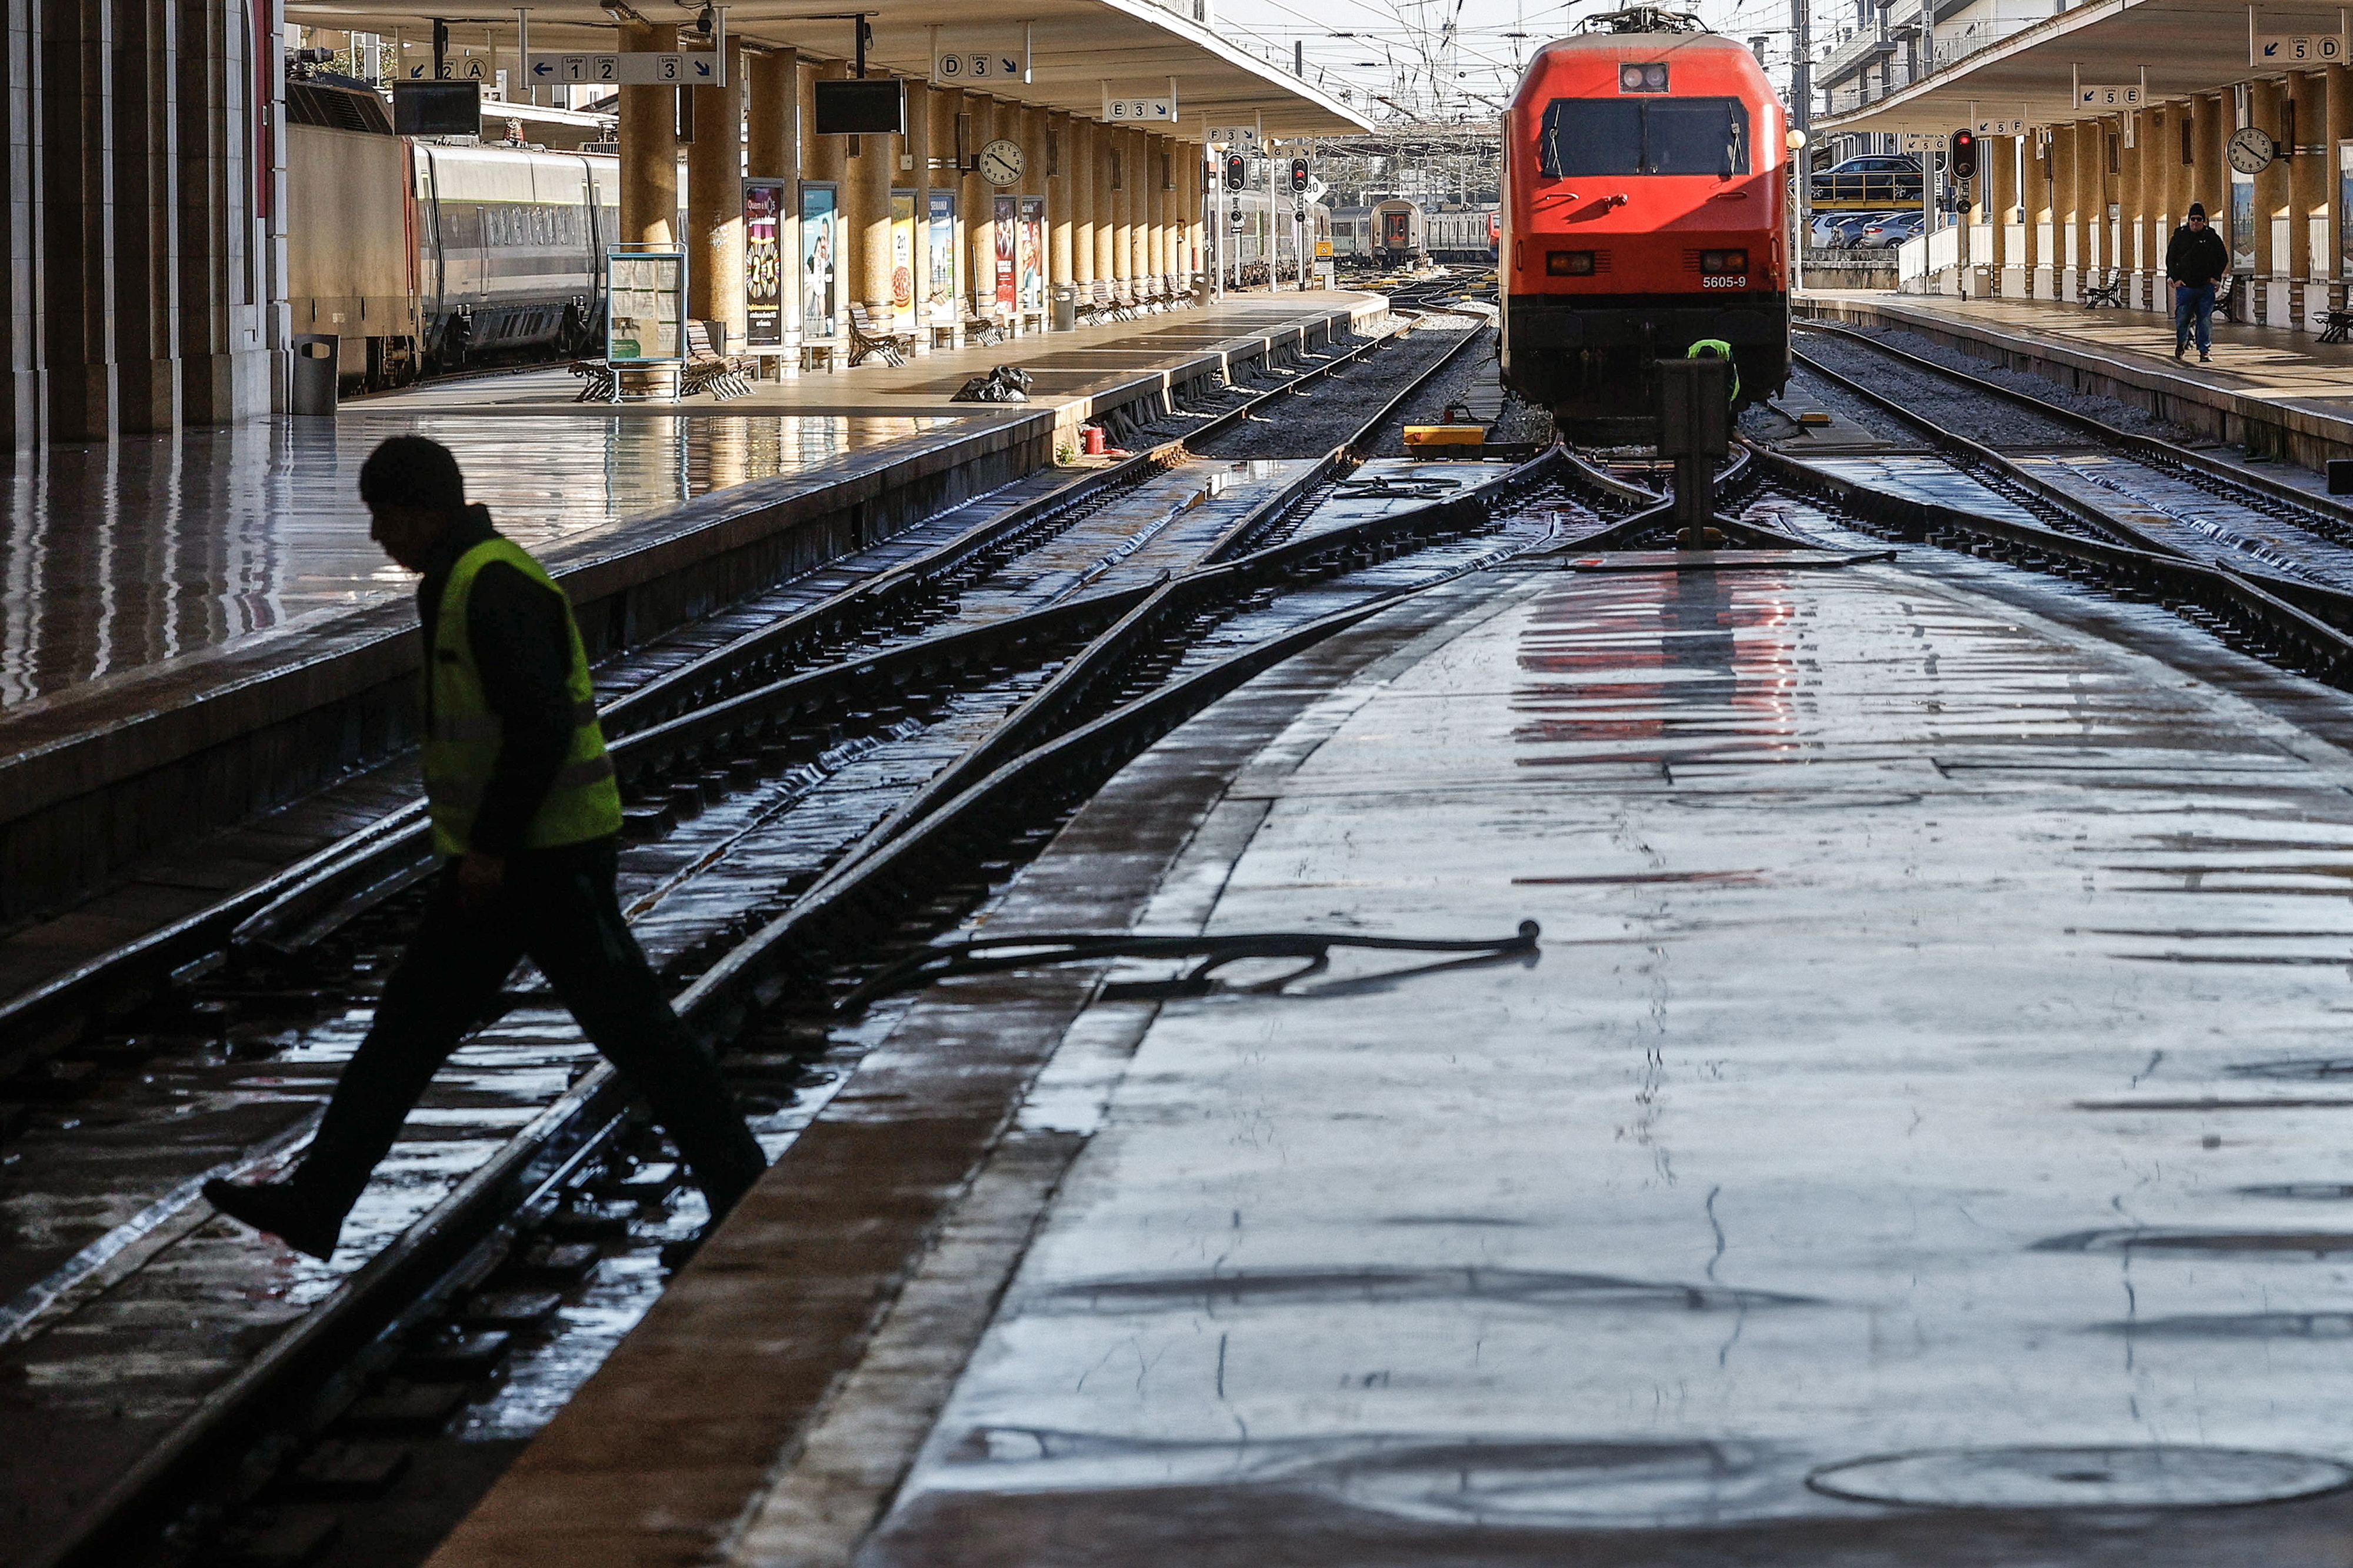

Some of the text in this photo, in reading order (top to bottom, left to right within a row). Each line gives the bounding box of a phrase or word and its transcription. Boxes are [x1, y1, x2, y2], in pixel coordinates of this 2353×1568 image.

[2296, 42, 2335, 58] 5 D
[444, 64, 482, 79] 2 A
[571, 64, 675, 79] 1 2 3
[946, 59, 985, 75] D 3
[2107, 91, 2136, 103] 5 E
[1115, 105, 1143, 116] E 3
[1998, 122, 2021, 132] 5 F
[1211, 131, 1234, 140] F 3
[1274, 148, 1281, 156] G
[1703, 276, 1746, 288] 5605-9
